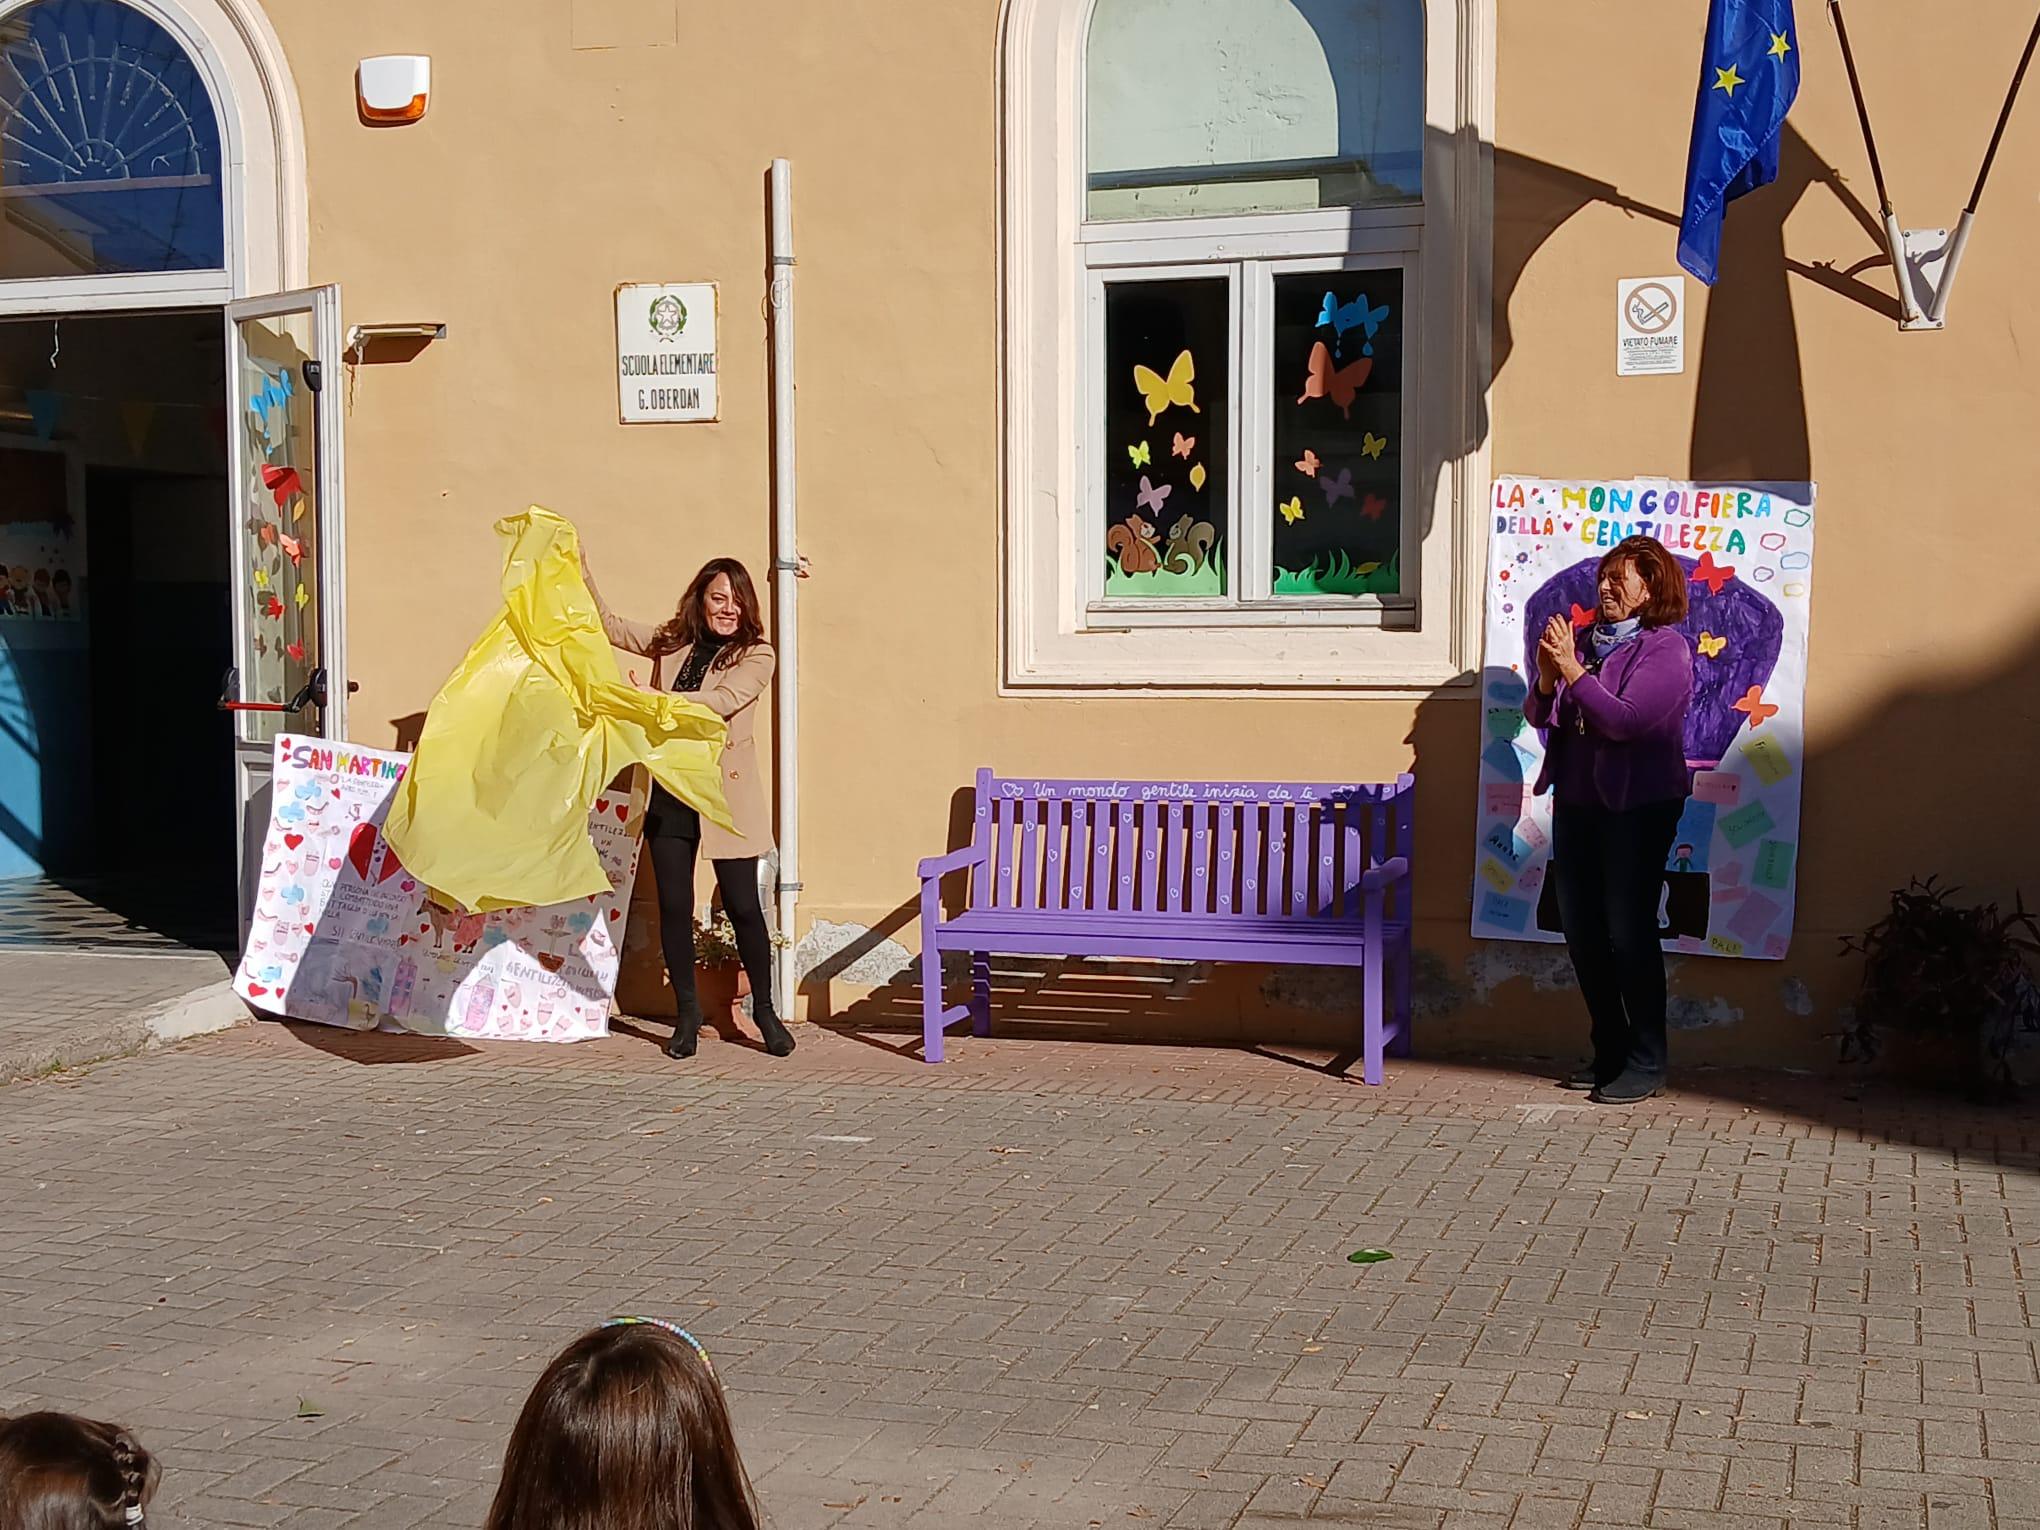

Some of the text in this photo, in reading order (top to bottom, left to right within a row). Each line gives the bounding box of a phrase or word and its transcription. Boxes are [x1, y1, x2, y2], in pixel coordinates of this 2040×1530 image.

[1623, 336, 1678, 347] VIETATO FUMARE
[622, 353, 716, 376] SCUOLA ELEMENTARE
[638, 388, 700, 410] G. OBERDAN
[1496, 484, 1525, 508] LA
[1496, 515, 1746, 555] DELLA GENTILEZZA
[291, 745, 333, 771] SAN
[1033, 781, 1318, 800] Un mondo gentile inizia da te
